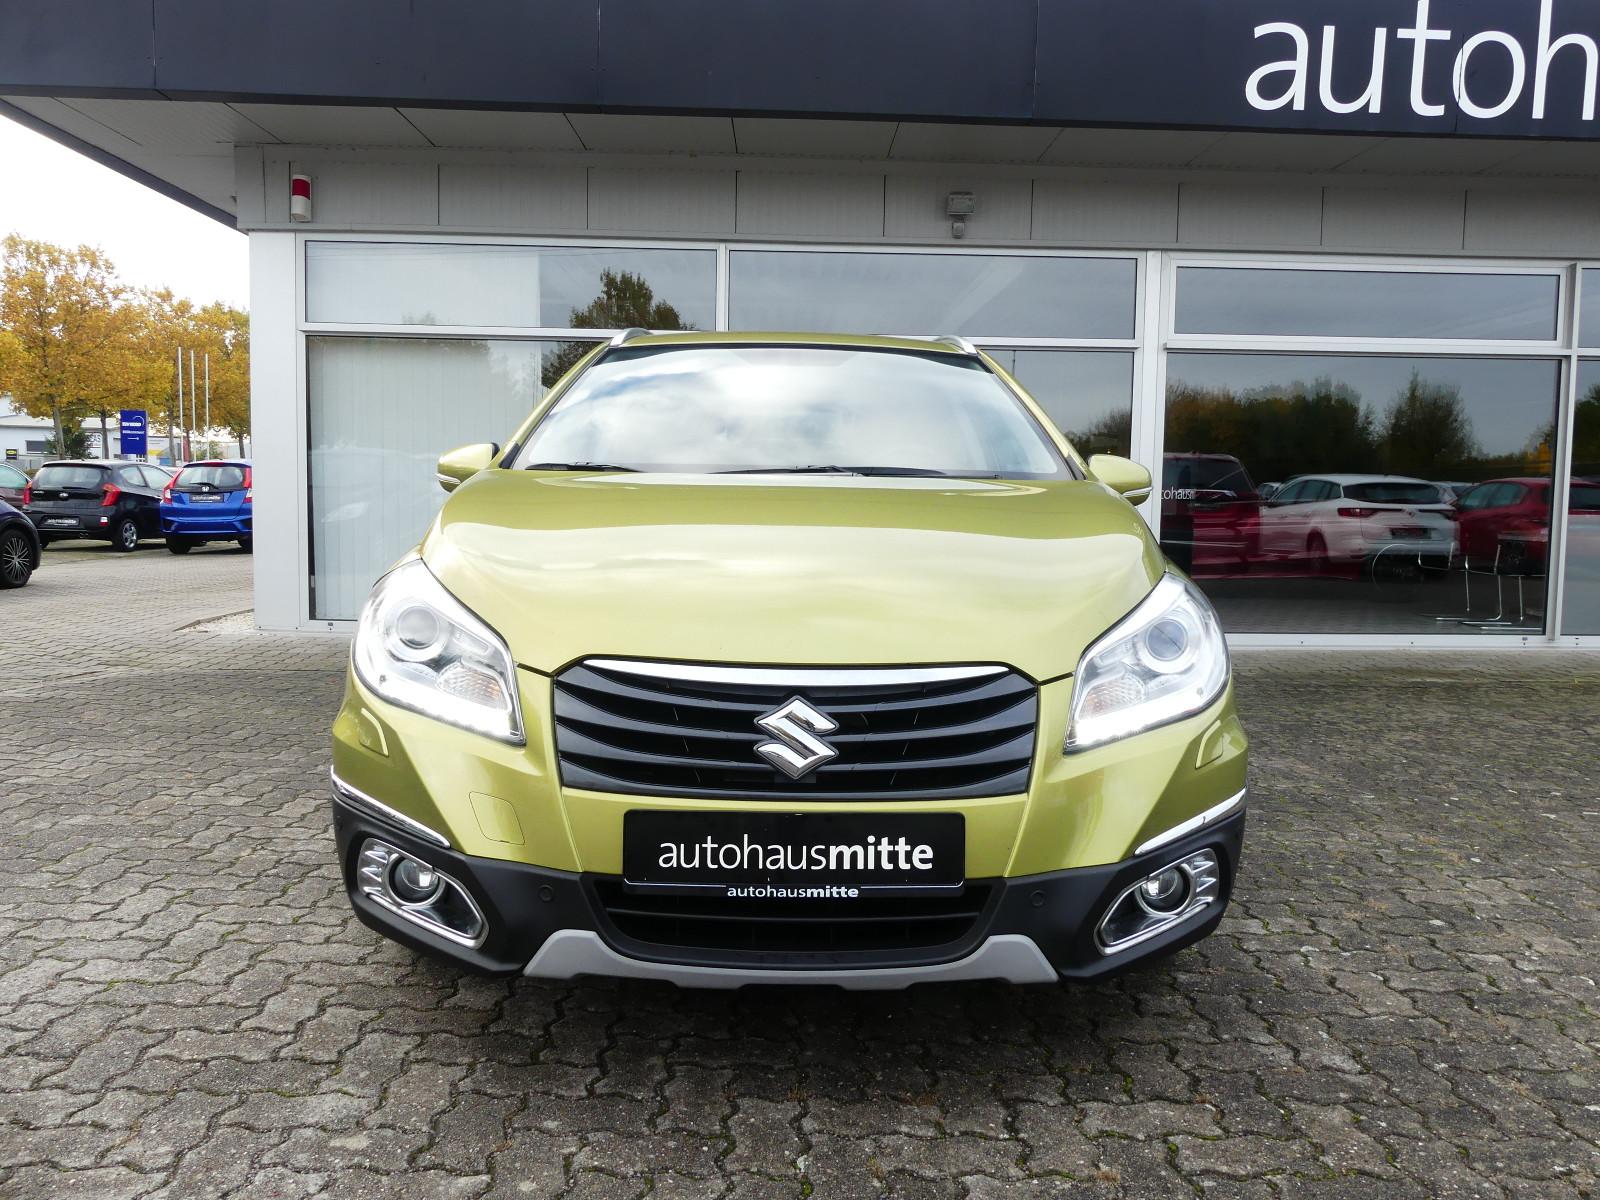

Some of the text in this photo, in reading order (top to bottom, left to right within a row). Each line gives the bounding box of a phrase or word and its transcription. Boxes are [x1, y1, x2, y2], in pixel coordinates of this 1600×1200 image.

[1246, 0, 1598, 120] autoh
[659, 834, 933, 869] autohausmitte
[728, 885, 858, 897] autohausmitte
